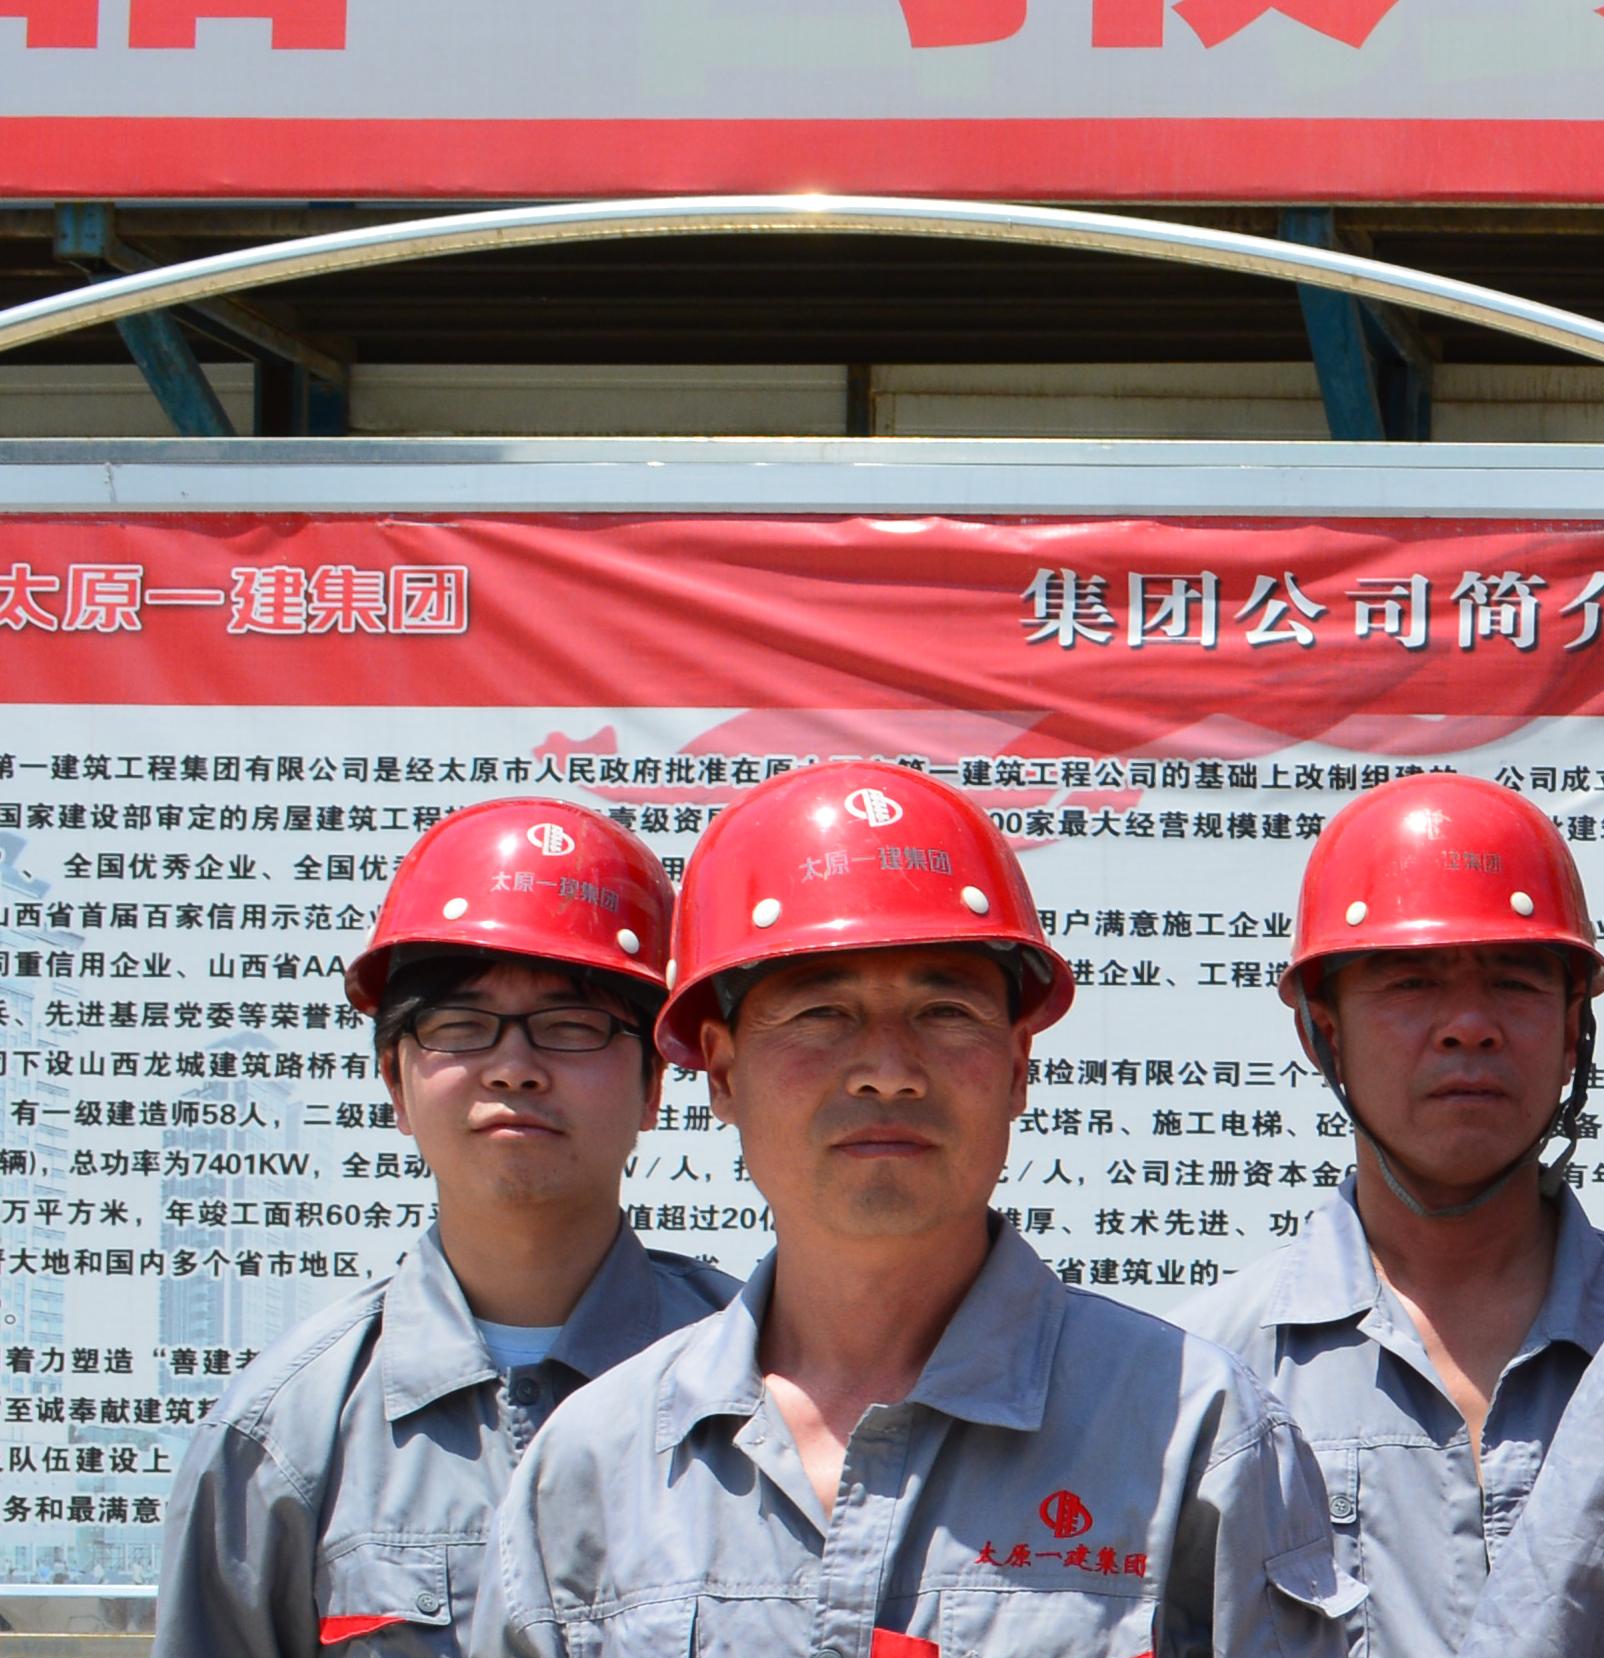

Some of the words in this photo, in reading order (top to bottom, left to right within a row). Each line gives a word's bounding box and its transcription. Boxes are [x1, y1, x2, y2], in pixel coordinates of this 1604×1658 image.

[0, 562, 468, 634] 太原一建集团
[0, 803, 468, 833] 国家建设部审定的房屋建筑工程
[799, 847, 953, 882] 太原一建集团
[490, 870, 620, 914] 太原一建集团
[0, 902, 382, 931] 西省首届百家信用示范企
[0, 1446, 172, 1474] 队伍建设上
[3, 1495, 168, 1524] 务和最满意
[974, 1540, 1147, 1578] 太原一建集团
